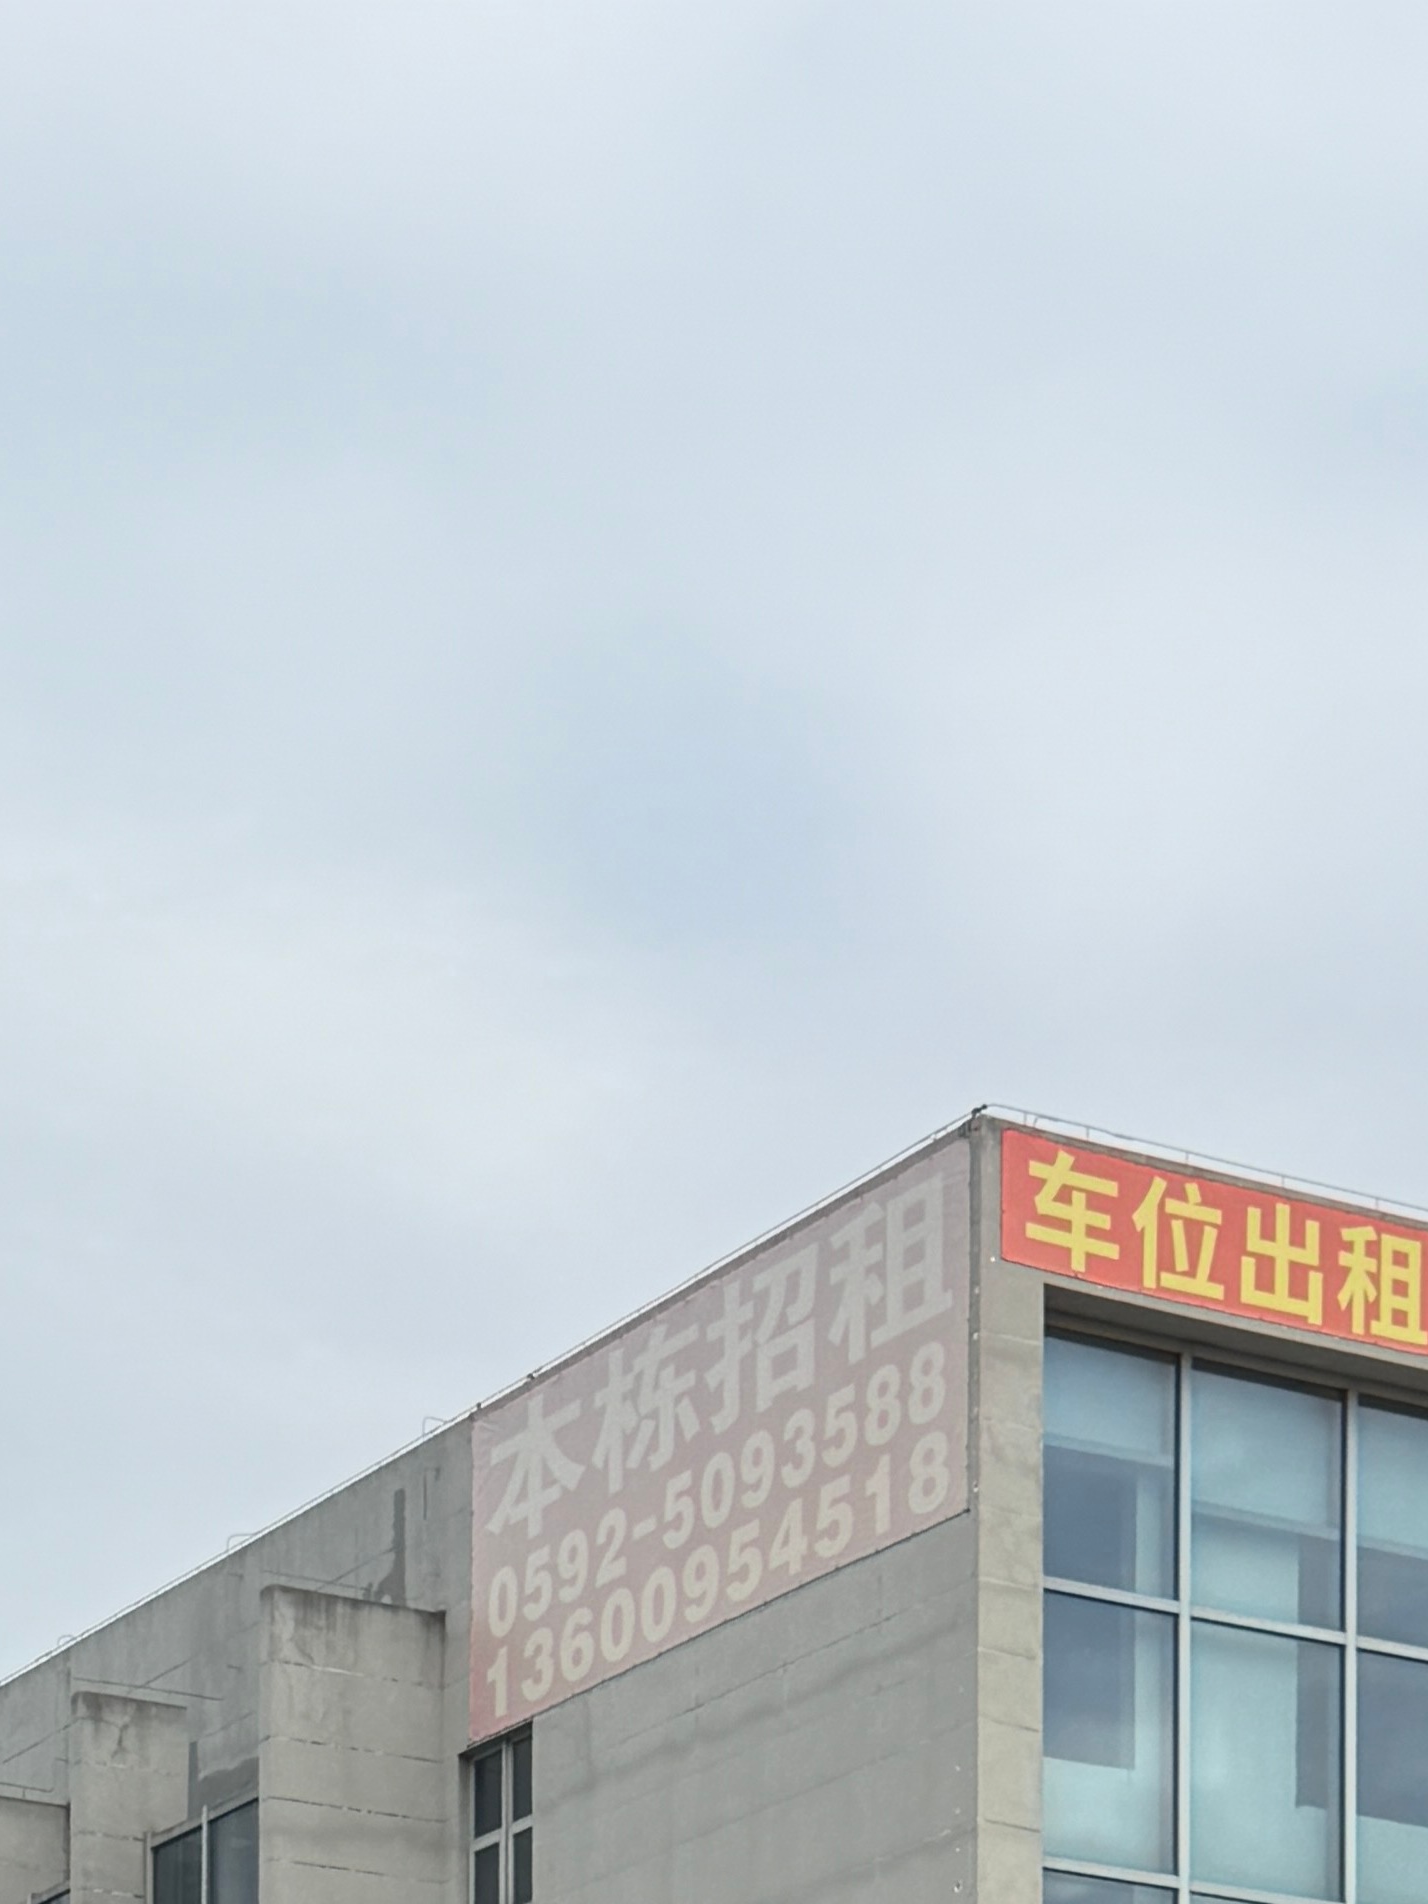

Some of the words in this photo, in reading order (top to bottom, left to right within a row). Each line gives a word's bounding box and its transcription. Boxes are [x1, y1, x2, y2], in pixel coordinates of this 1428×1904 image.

[483, 1170, 954, 1540] 本栋招租
[487, 1340, 947, 1640] 0592-5093588
[486, 1431, 950, 1719] 13600954518
